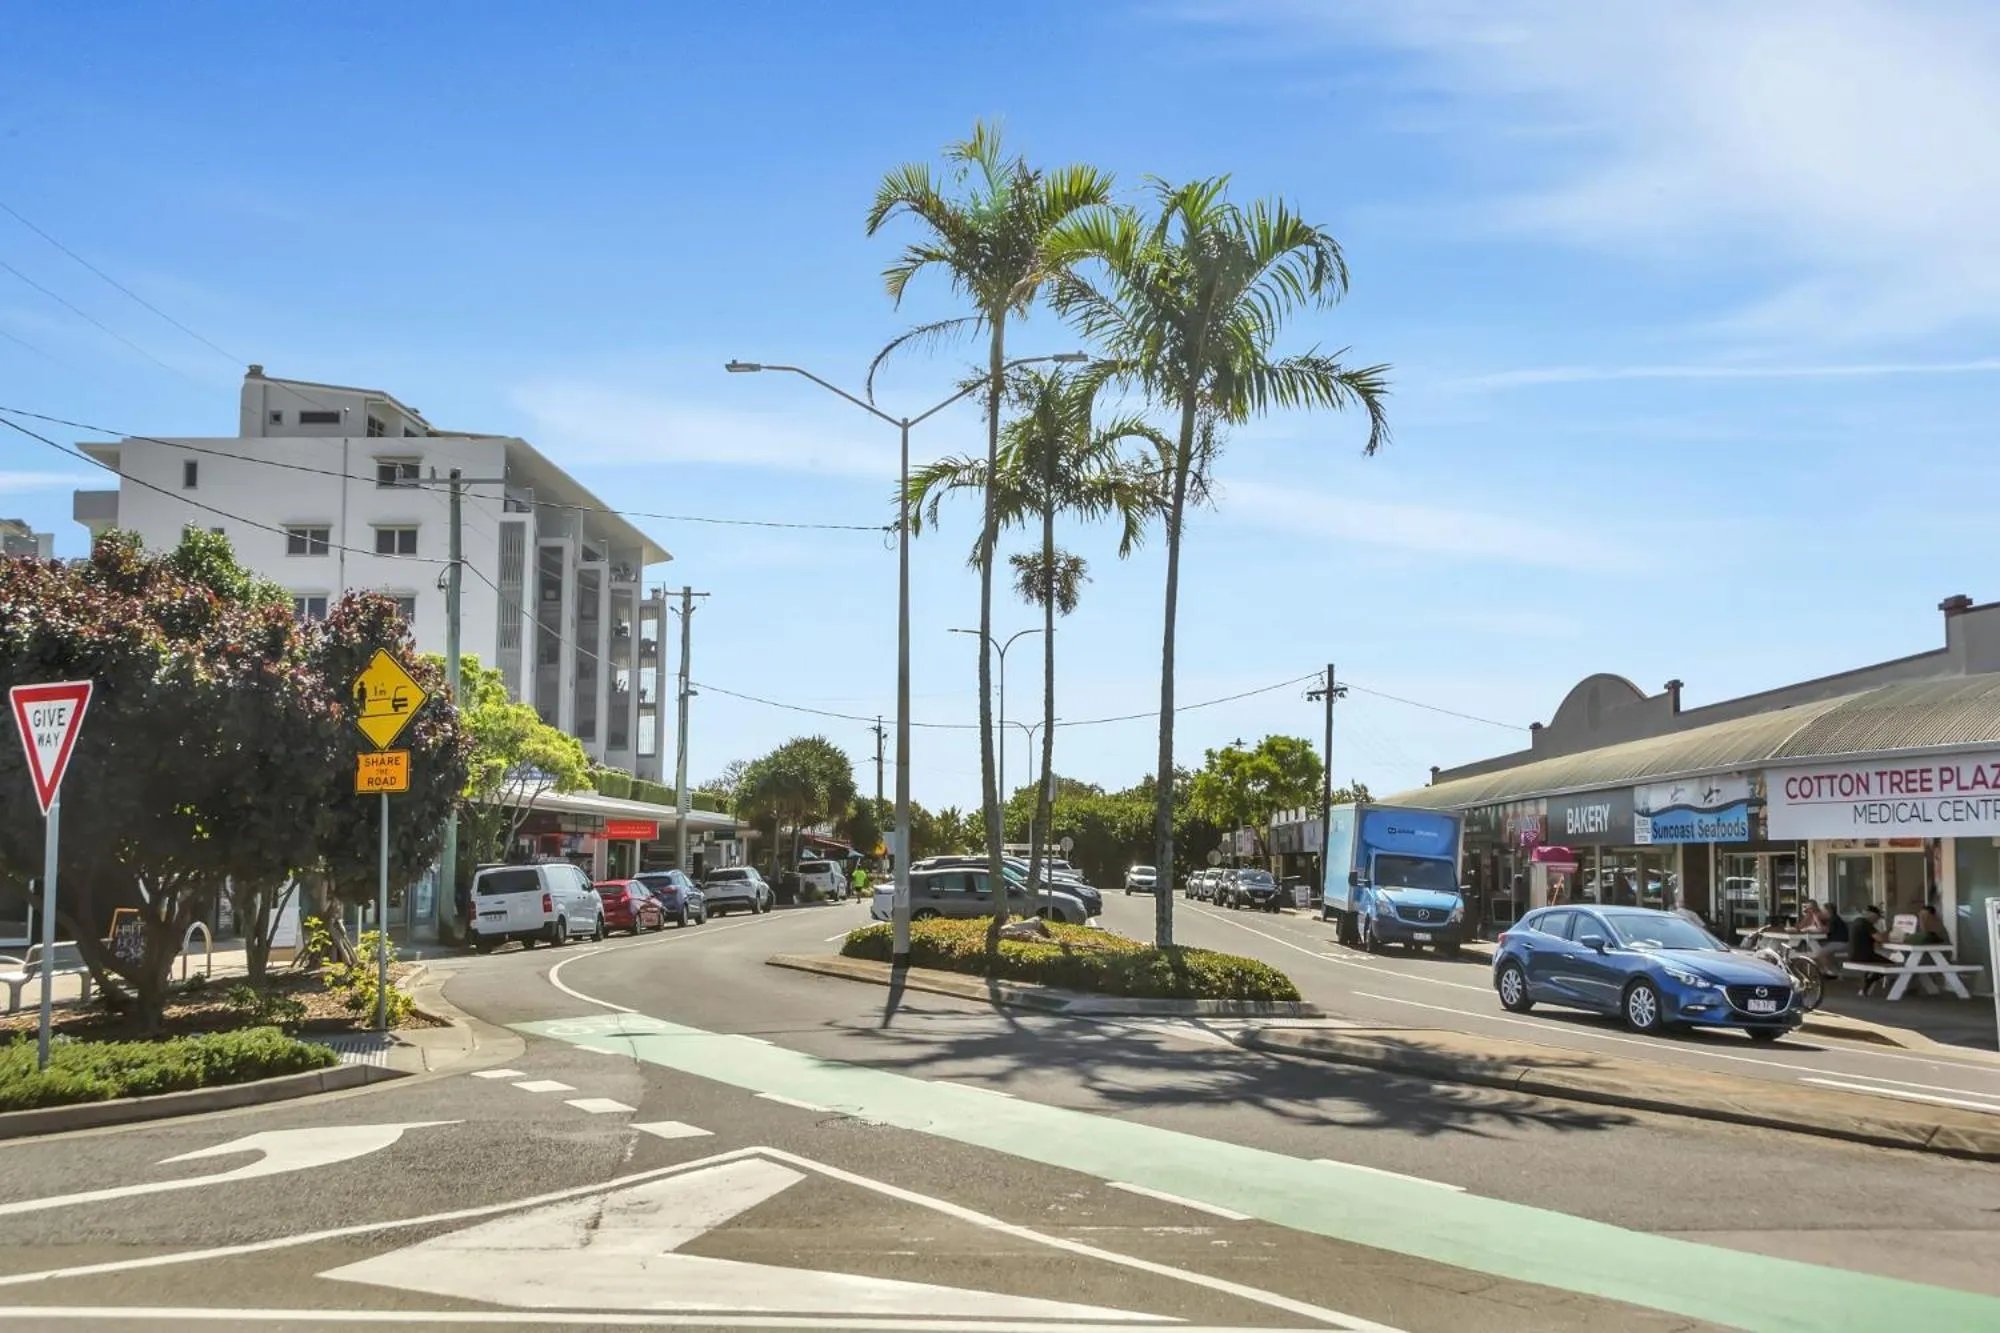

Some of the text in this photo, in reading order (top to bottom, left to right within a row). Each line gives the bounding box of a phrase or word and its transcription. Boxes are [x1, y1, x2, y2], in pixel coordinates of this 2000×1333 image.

[33, 707, 66, 728] GIVE
[37, 731, 60, 748] WAY
[364, 756, 401, 767] SHARE
[367, 776, 397, 787] ROAD
[1785, 771, 1870, 799] COTTON
[1875, 768, 1933, 795] TREE
[1566, 803, 1611, 835] BAKERY
[1853, 802, 1933, 824] MEDICAL
[1652, 816, 1747, 840] Suncoast Seafoods
